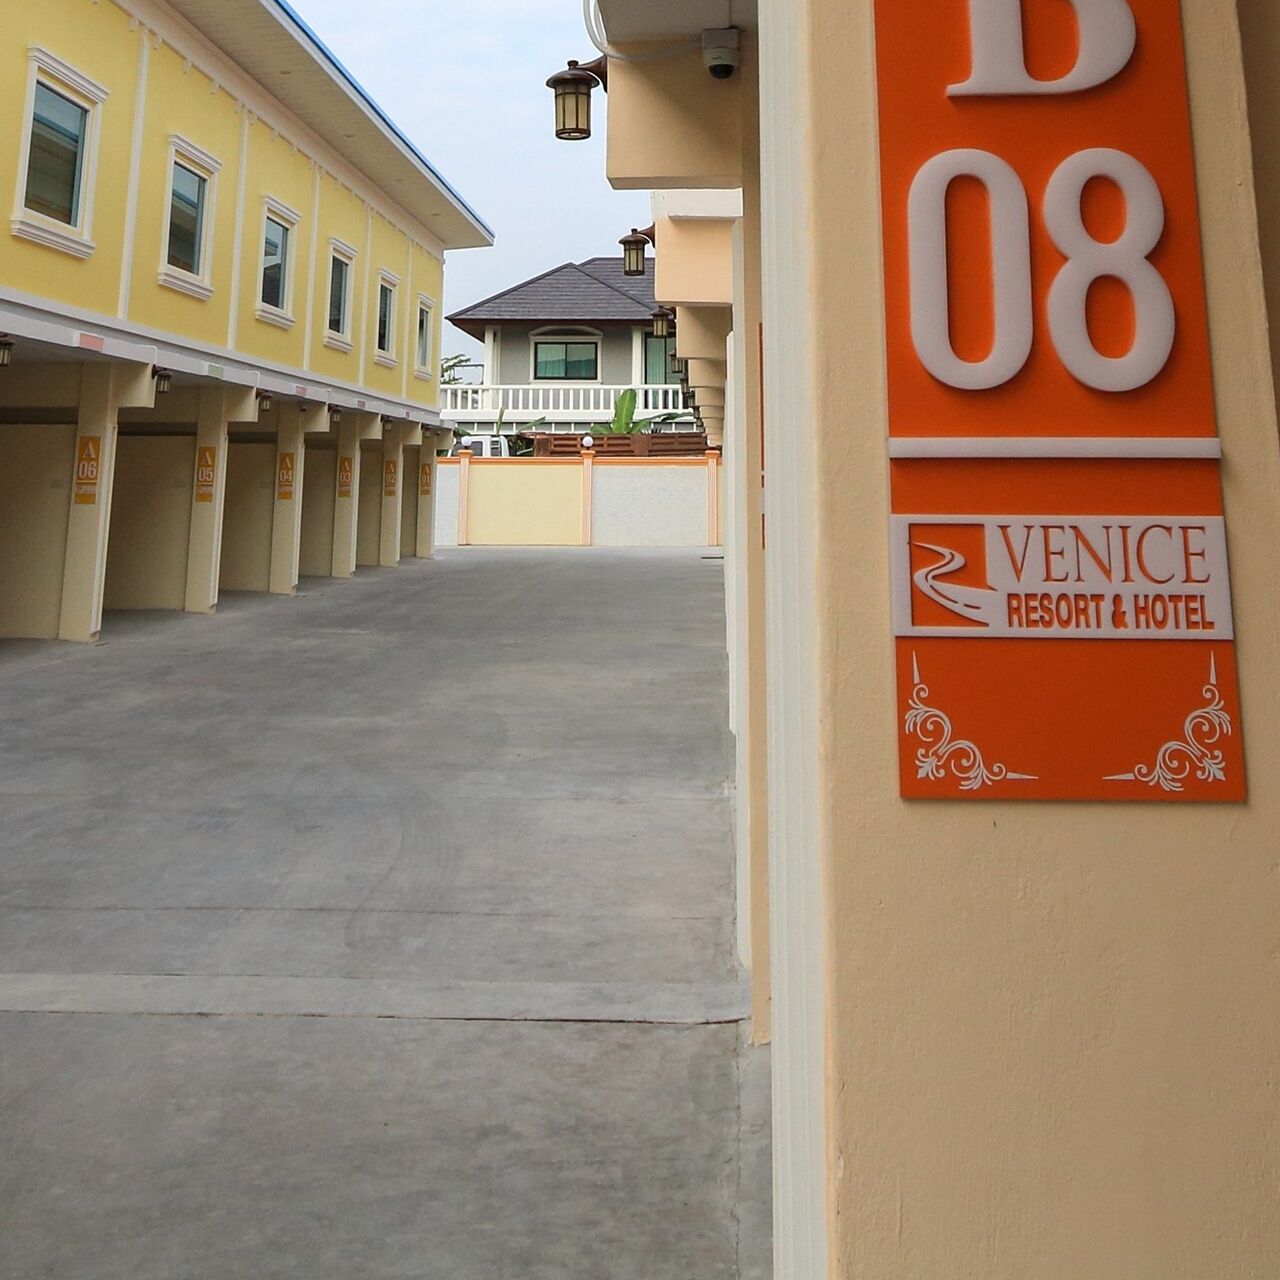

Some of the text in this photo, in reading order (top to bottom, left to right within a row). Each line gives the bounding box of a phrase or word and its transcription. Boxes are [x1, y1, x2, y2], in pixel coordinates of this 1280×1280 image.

[907, 147, 1175, 393] 08
[82, 442, 96, 458] A
[201, 451, 213, 465] A
[79, 461, 96, 479] 06
[282, 457, 292, 469] A
[198, 467, 213, 481] 05
[280, 470, 293, 482] 04
[997, 524, 1211, 585] VENICE
[1006, 592, 1215, 631] RESORT & HOTEL
